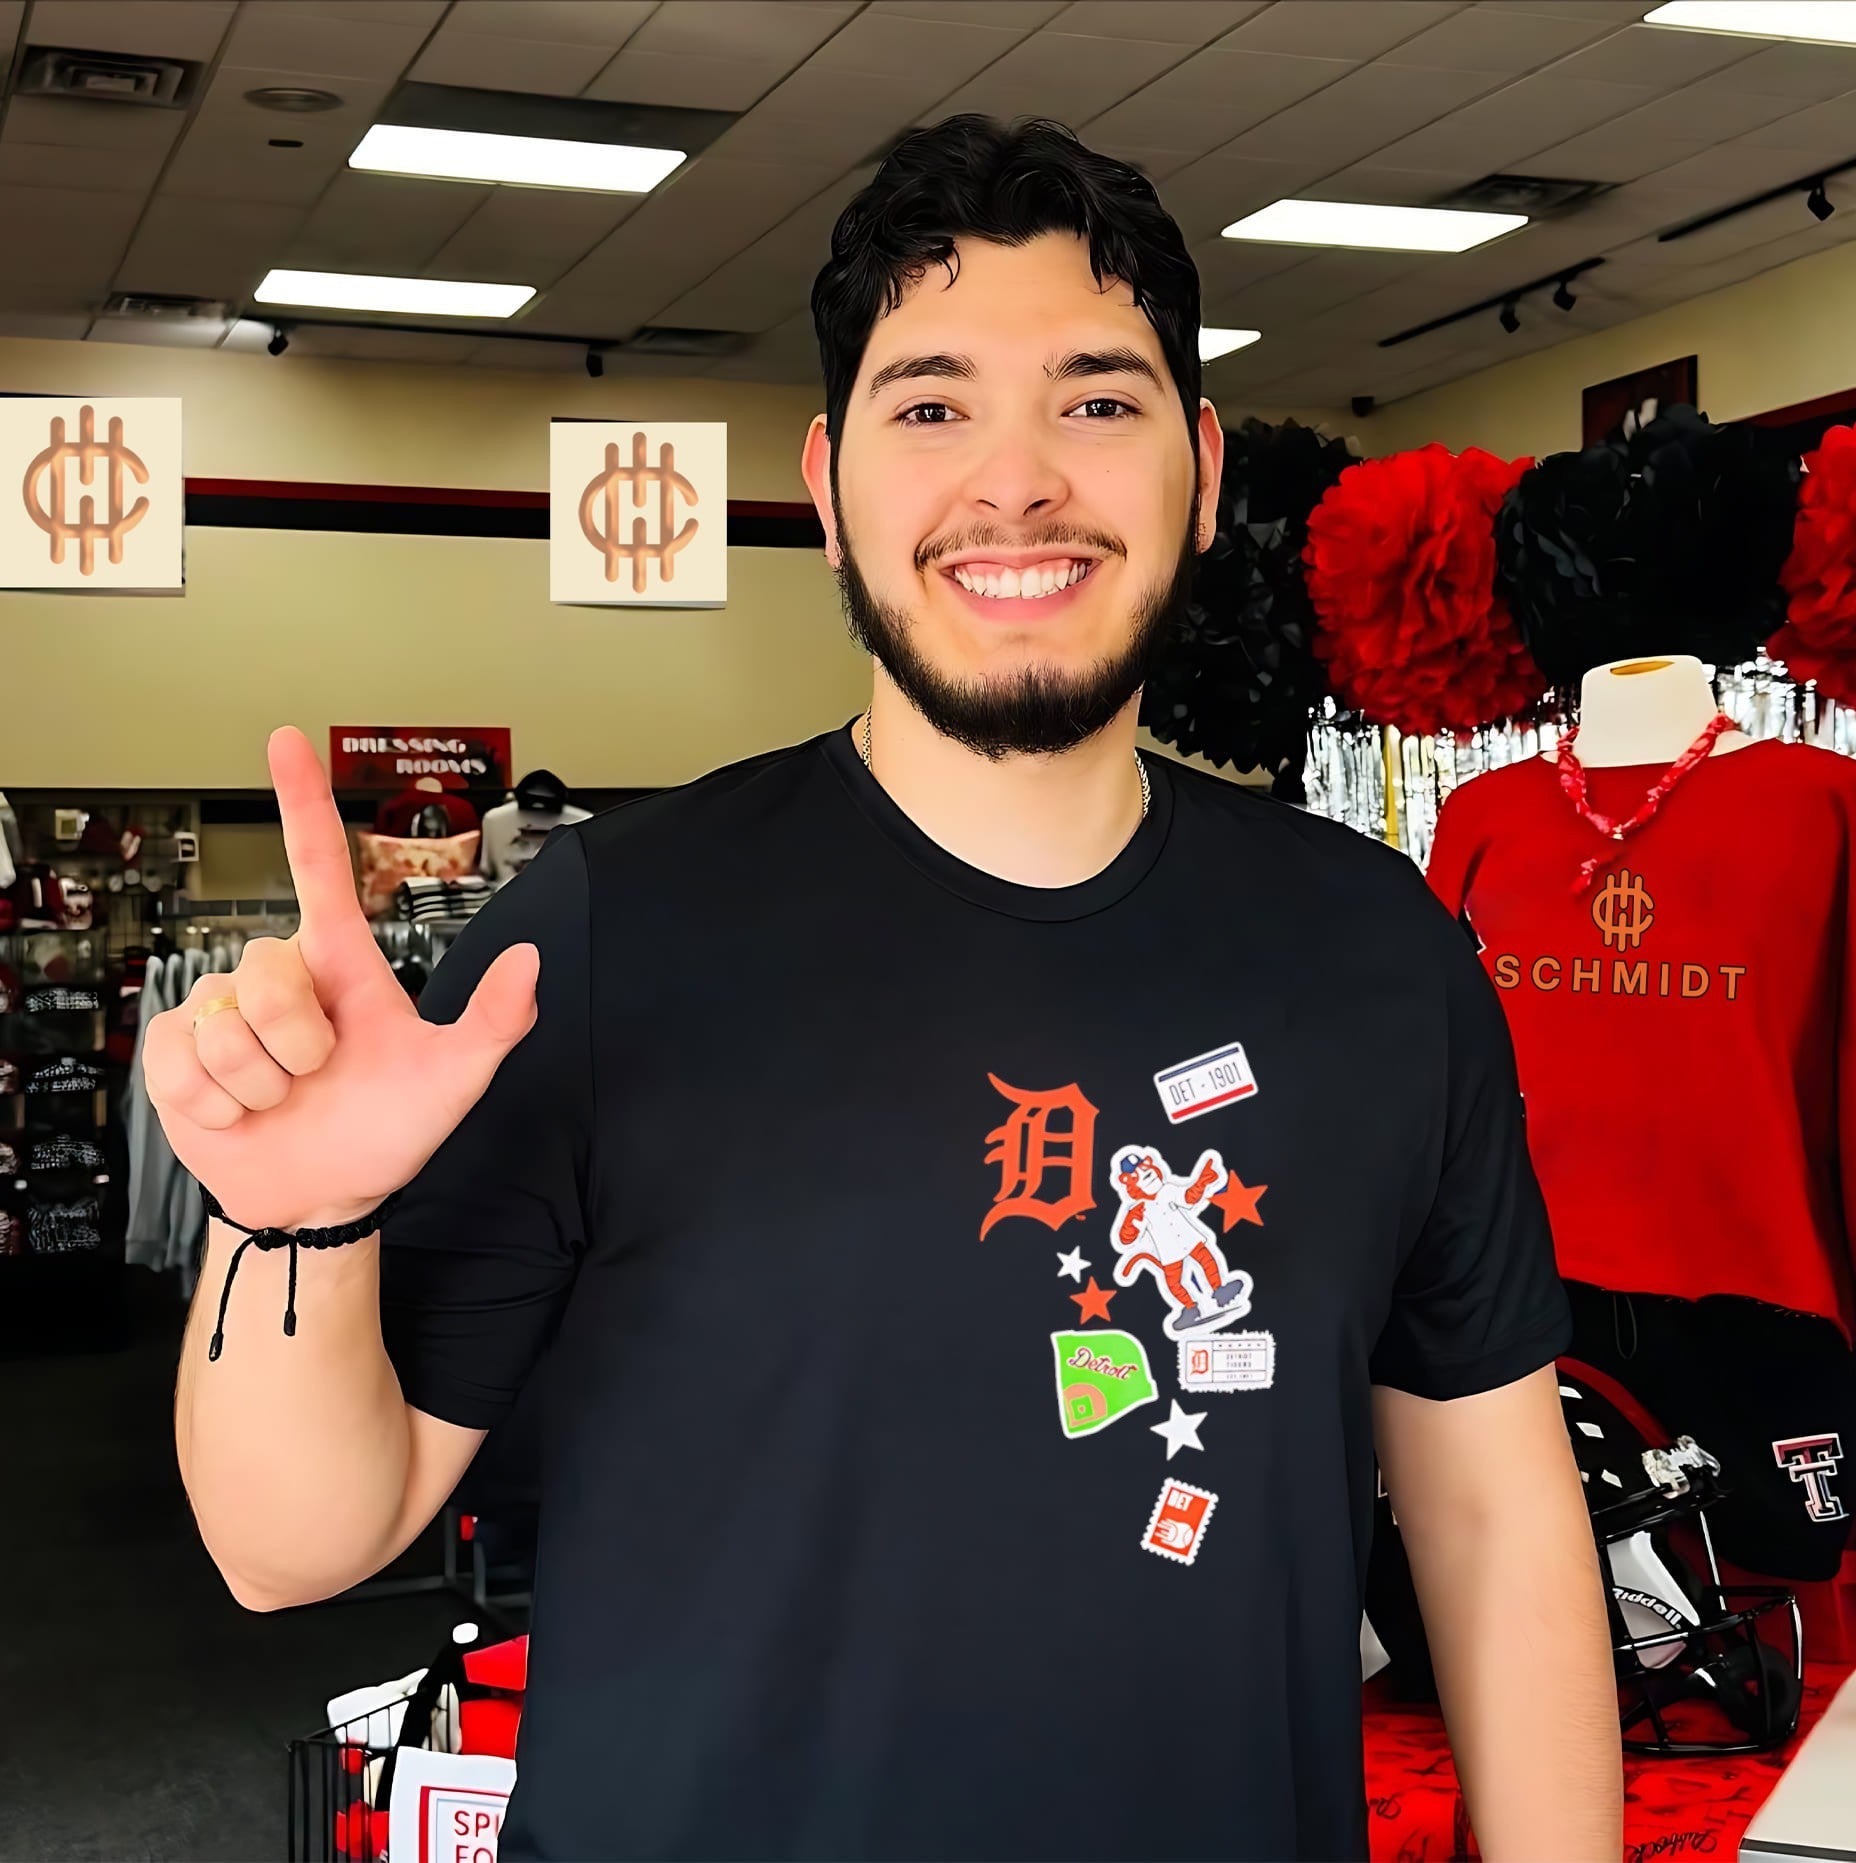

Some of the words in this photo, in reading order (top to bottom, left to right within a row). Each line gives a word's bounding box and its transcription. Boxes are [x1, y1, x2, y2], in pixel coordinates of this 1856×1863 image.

[342, 737, 467, 754] DRESSING
[396, 758, 487, 775] ROOMS
[1494, 953, 1747, 1001] SCHMIDT
[1168, 1077, 1195, 1106] DET
[1208, 1061, 1243, 1091] 1901
[979, 1072, 1100, 1242] D
[1067, 1346, 1138, 1381] Detroit
